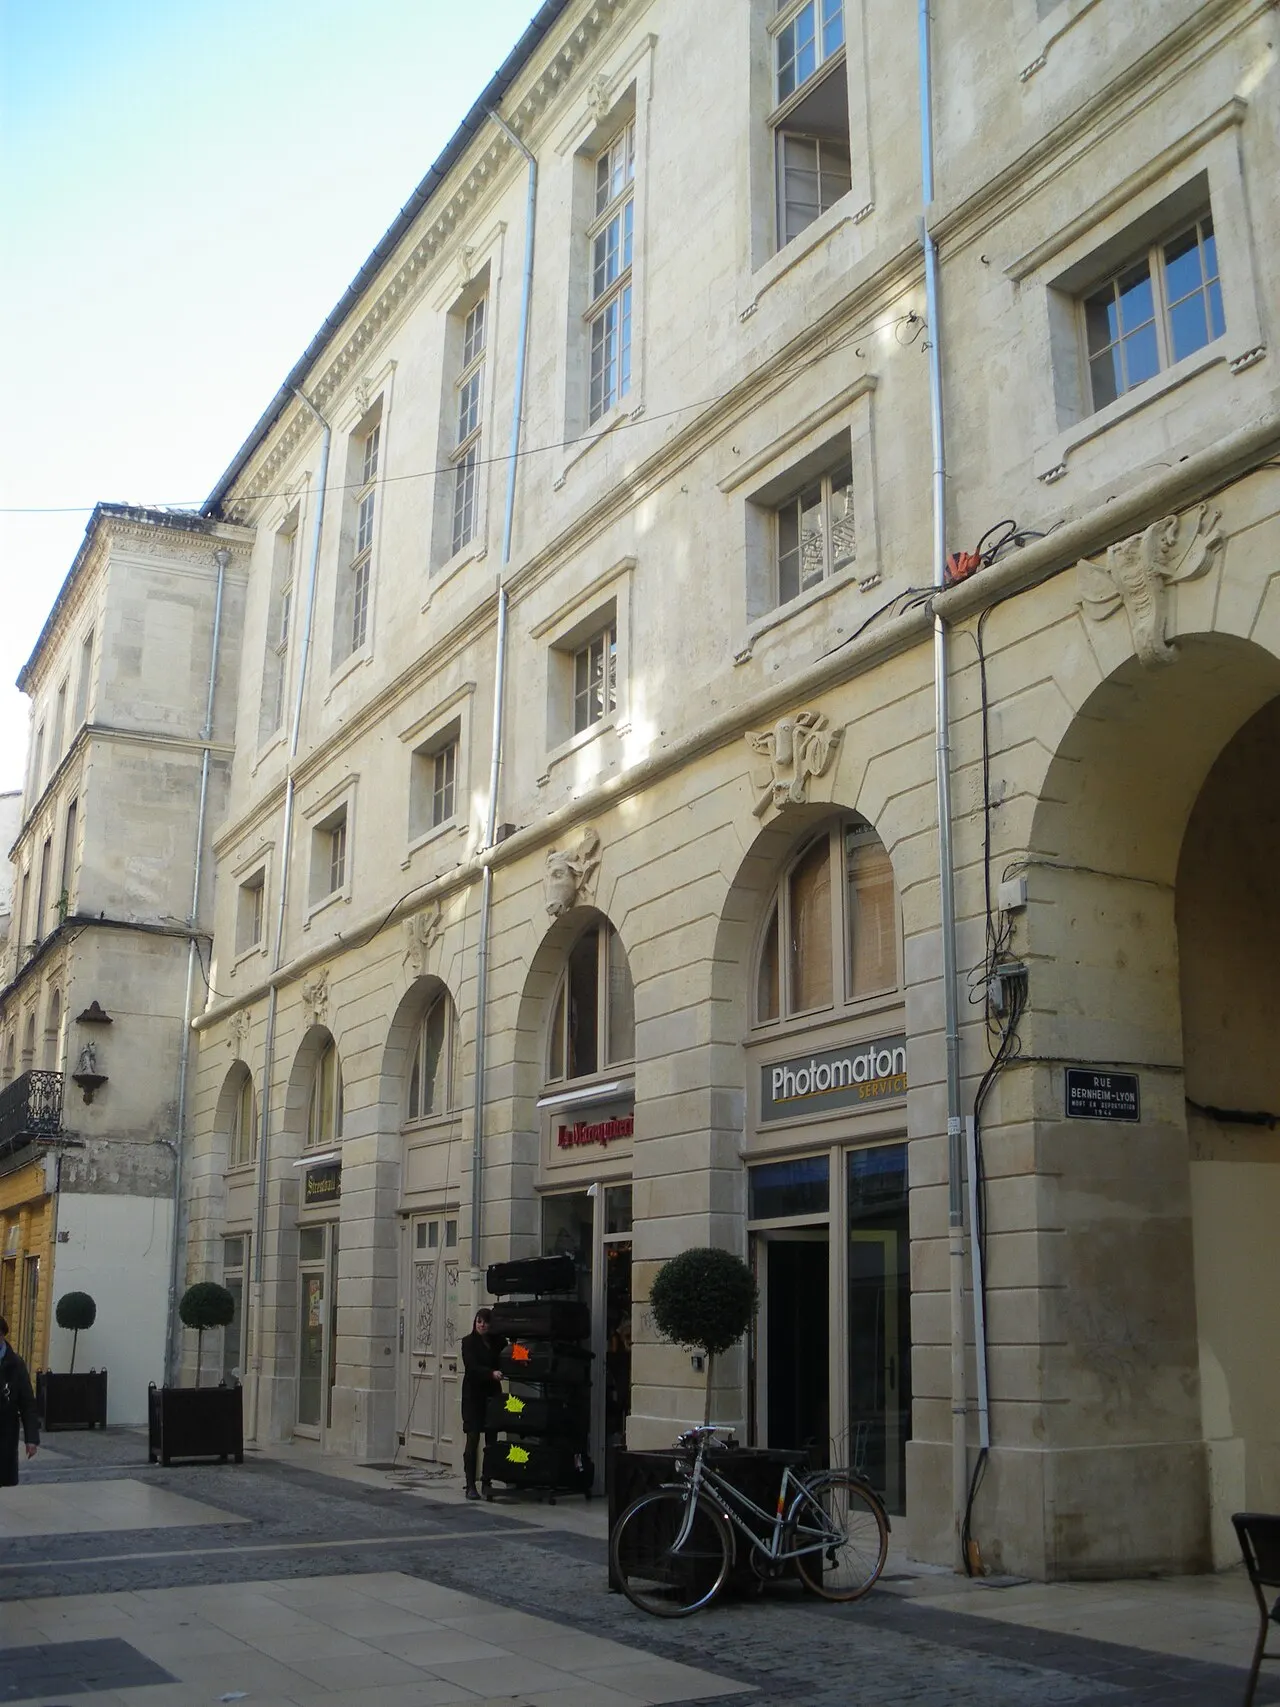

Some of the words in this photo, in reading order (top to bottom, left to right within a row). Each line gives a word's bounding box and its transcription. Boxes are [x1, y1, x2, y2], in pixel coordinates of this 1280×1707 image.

[772, 1046, 906, 1101] Photomaton
[1093, 1076, 1112, 1088] RUE
[1071, 1087, 1135, 1102] BERNHEIM-LYON
